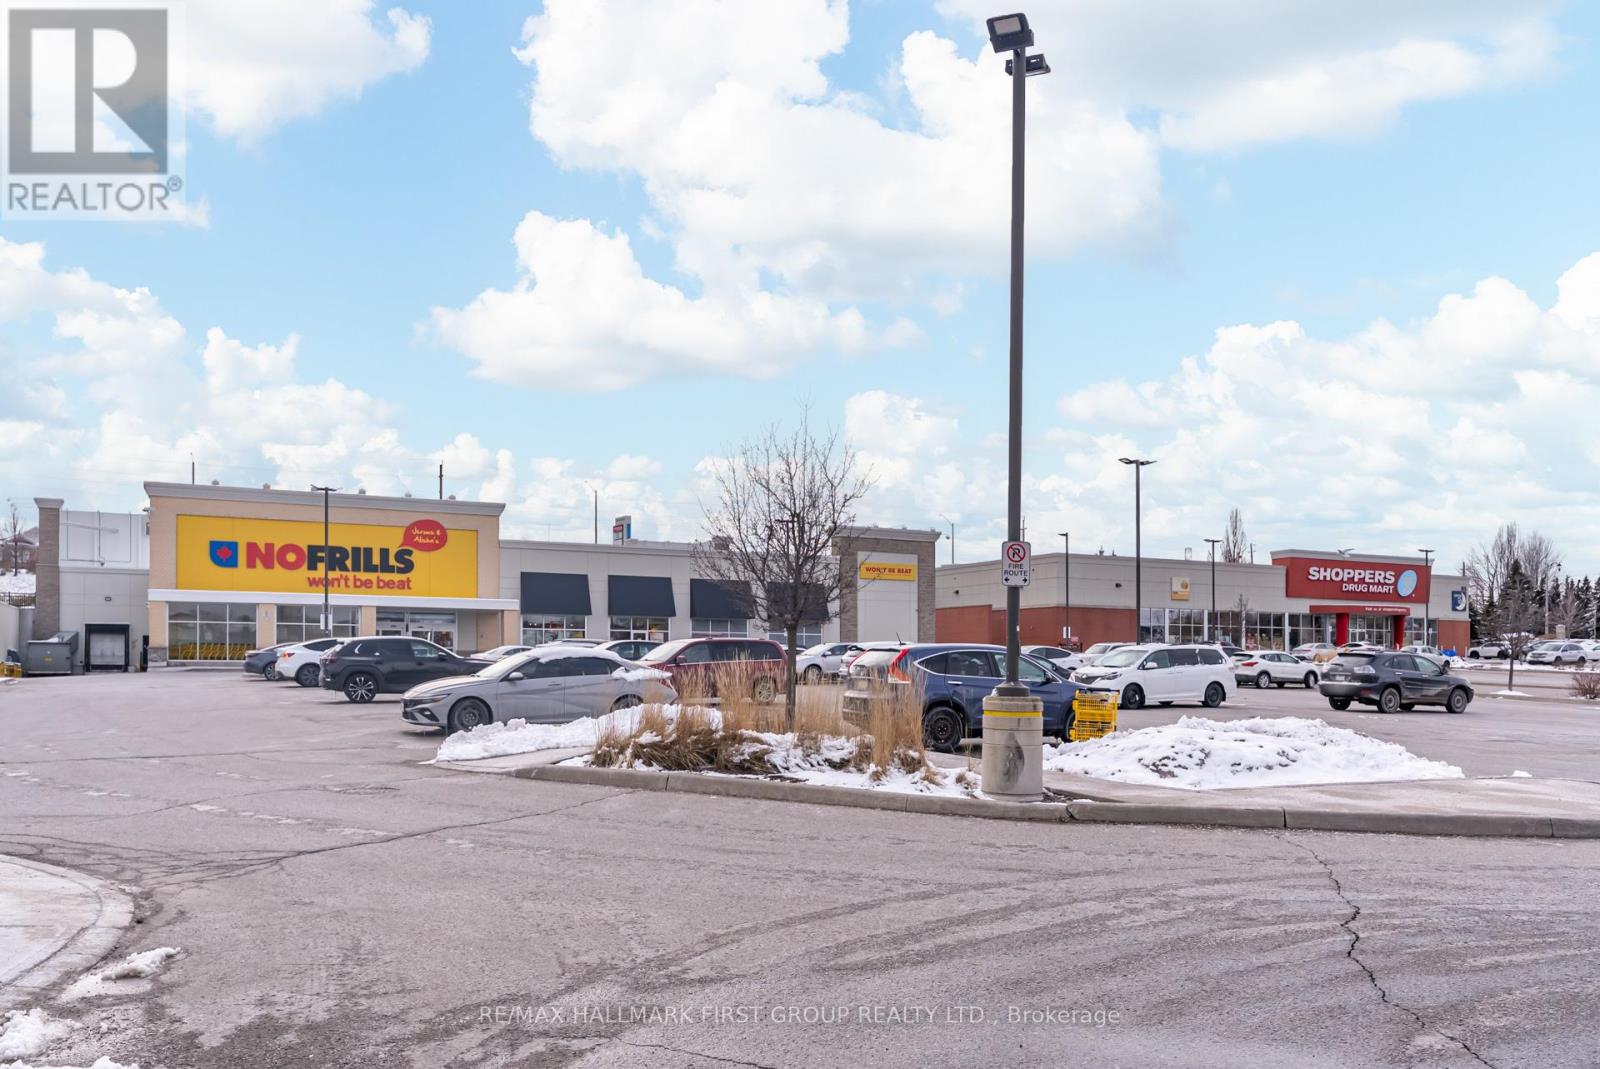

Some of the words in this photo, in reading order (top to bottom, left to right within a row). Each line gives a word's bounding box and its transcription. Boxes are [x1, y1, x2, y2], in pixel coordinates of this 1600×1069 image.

[1003, 569, 1028, 577] ROUTE
[1308, 566, 1396, 584] SHOPPERS
[307, 574, 350, 588] won't
[353, 574, 373, 589] be
[376, 575, 412, 590] beat
[1342, 583, 1368, 593] DRUG
[1369, 585, 1394, 594] MART
